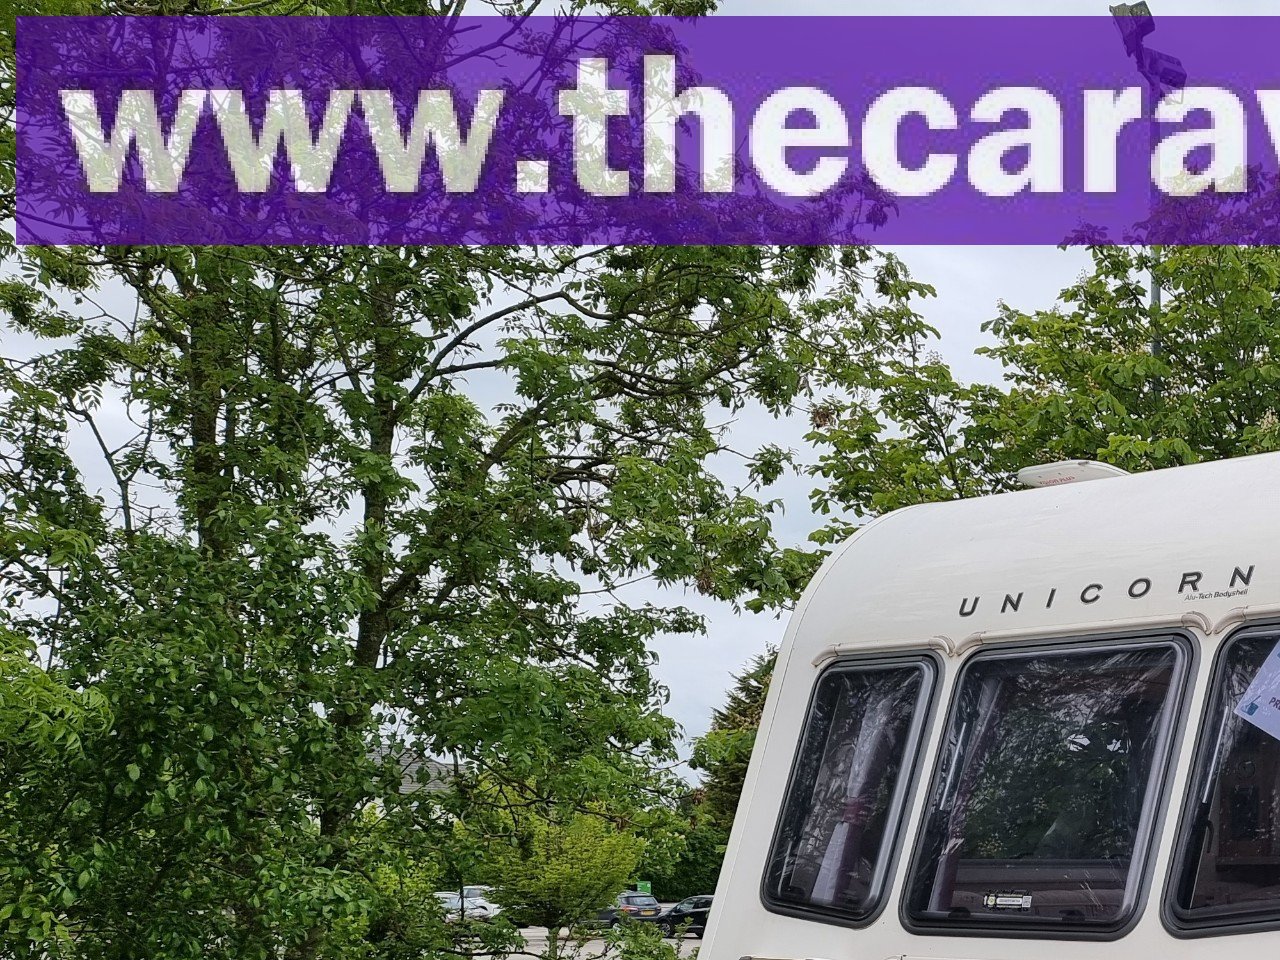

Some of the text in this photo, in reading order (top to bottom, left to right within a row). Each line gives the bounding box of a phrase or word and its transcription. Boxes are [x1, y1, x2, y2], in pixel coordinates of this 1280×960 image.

[959, 564, 1256, 618] UNICORN
[1183, 588, 1249, 601] Alu-Tech Bodyshell
